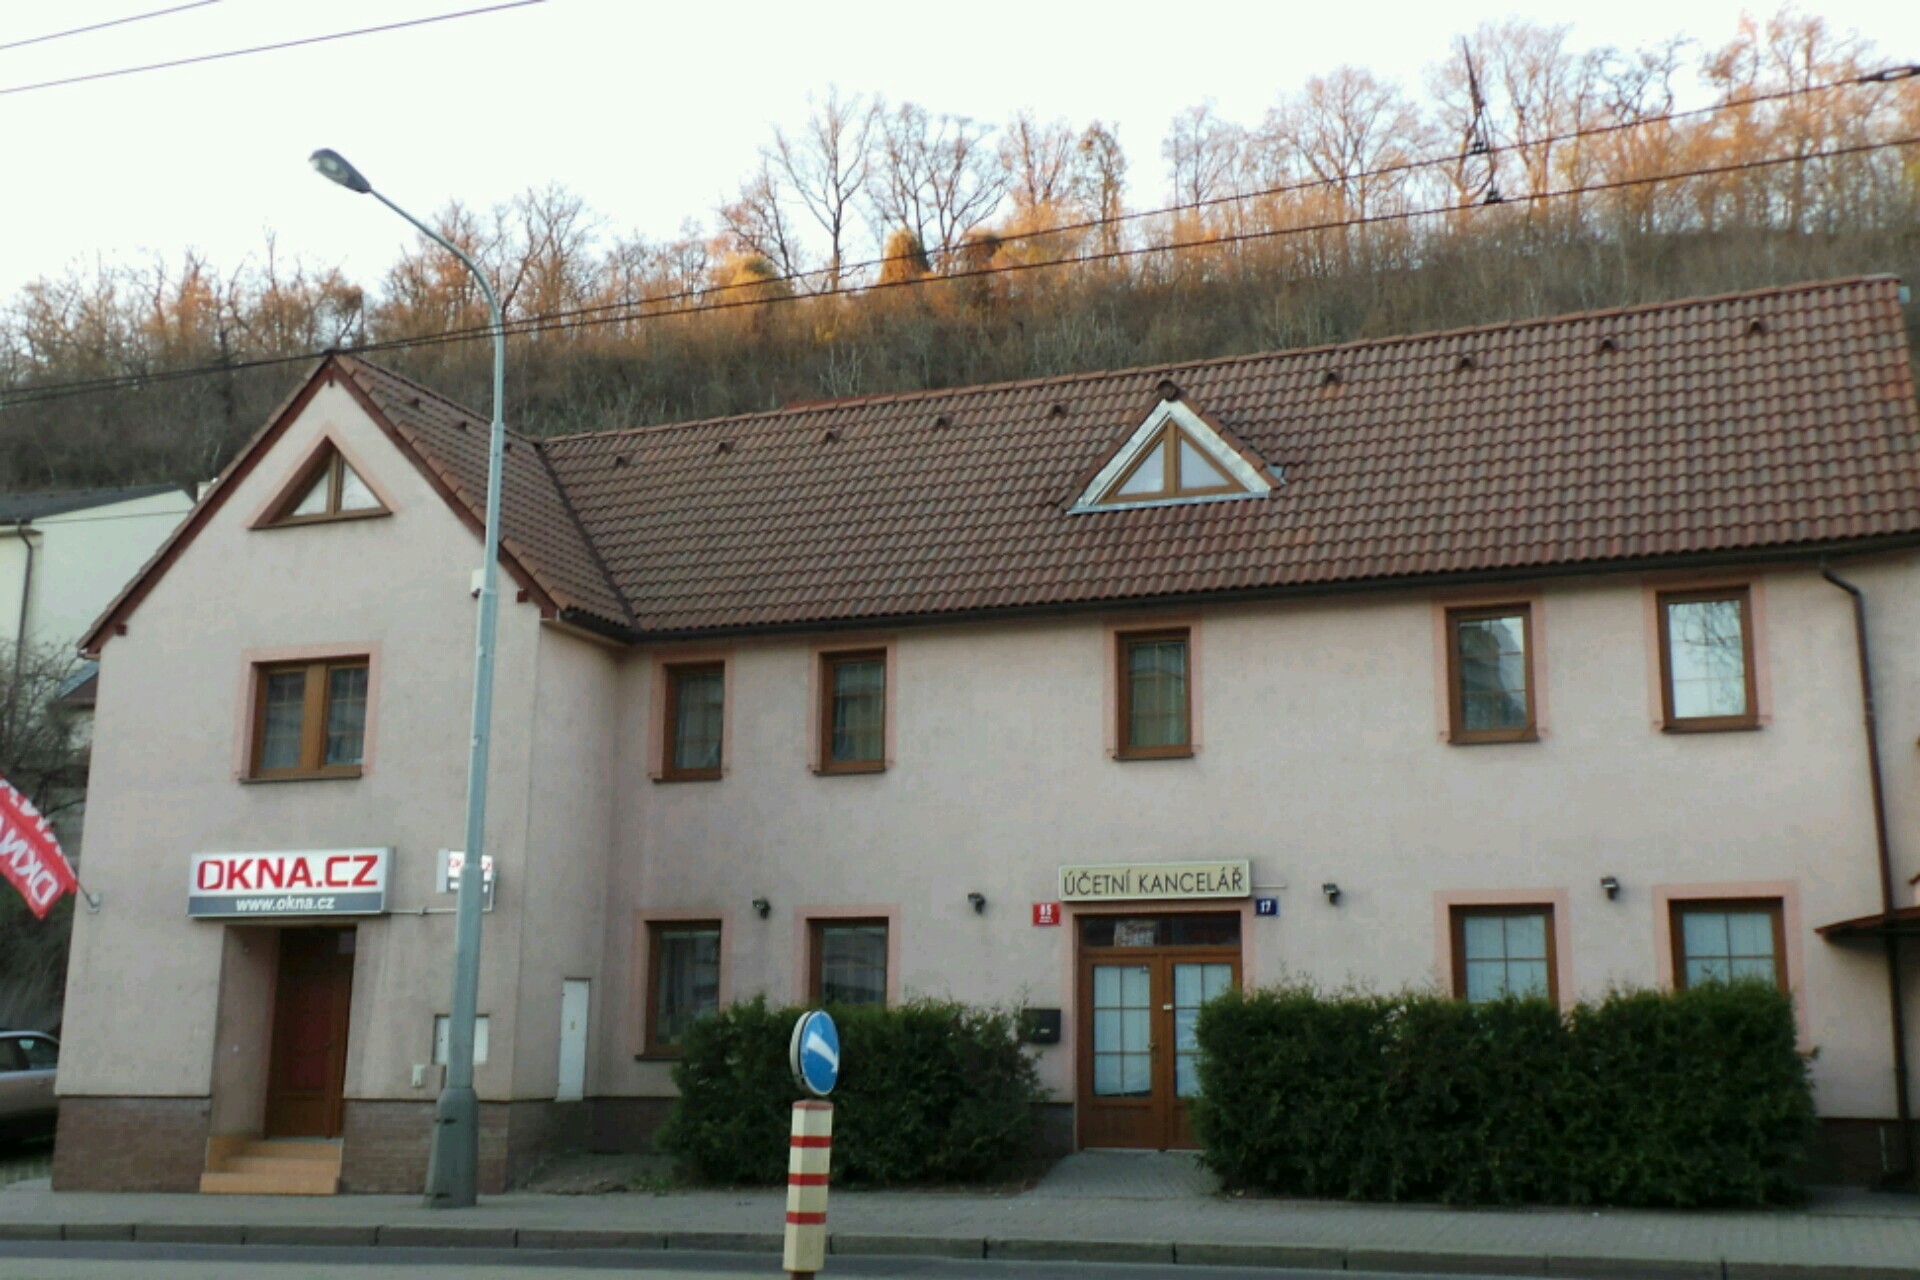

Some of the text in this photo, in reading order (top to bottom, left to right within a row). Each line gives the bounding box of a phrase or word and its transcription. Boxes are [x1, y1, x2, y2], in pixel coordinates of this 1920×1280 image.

[197, 855, 378, 890] OKNA.CZ
[1064, 867, 1243, 896] ÚČETNÍ KANCELÁŘ
[236, 896, 336, 912] www.okna.cz
